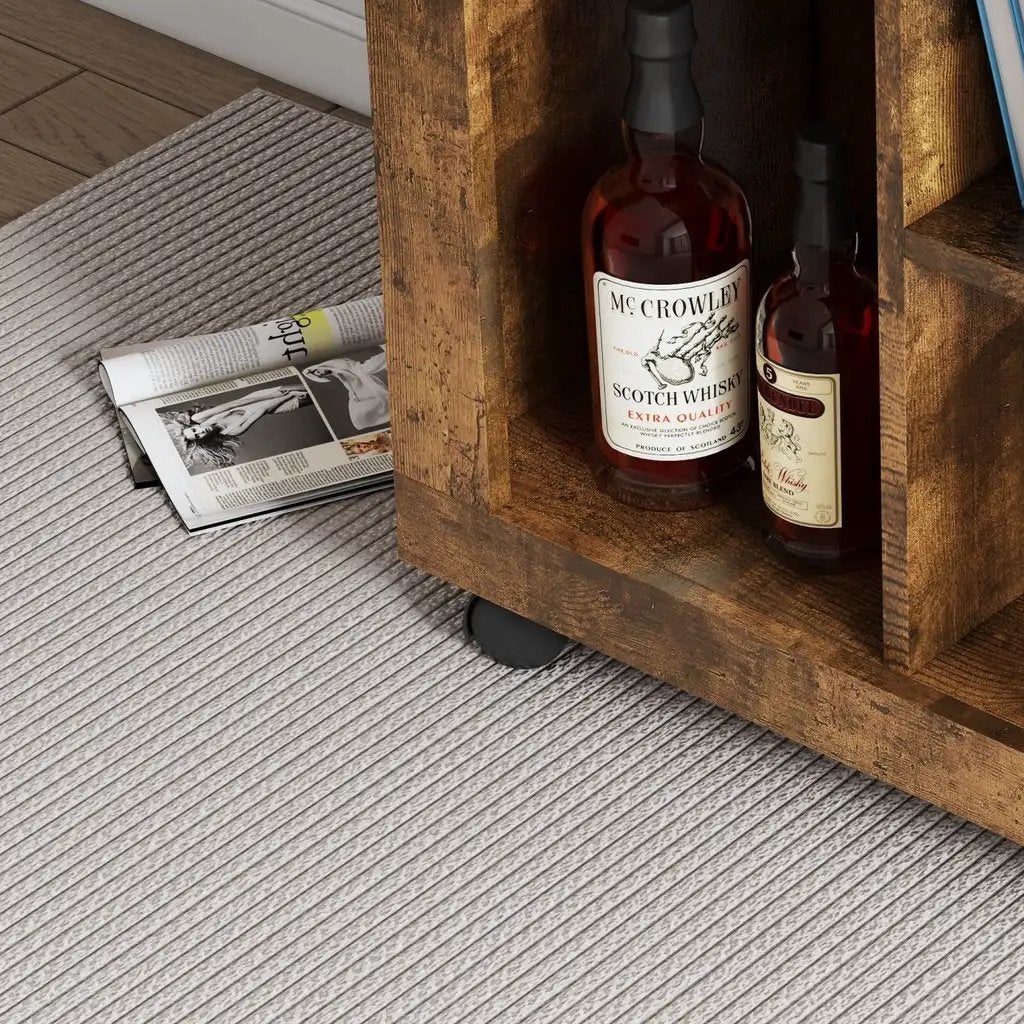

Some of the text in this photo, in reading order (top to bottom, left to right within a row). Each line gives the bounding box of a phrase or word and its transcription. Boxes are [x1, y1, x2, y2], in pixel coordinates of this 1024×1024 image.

[640, 276, 743, 319] CROWLEY
[612, 382, 678, 406] SCOTCH
[683, 367, 744, 405] WHISKY
[627, 399, 733, 423] EXTRA QUALITY
[629, 424, 657, 433] EXCLUSIVE
[659, 426, 689, 434] SELECTION
[698, 419, 718, 430] CHOICE
[719, 411, 737, 423] SCOTCH
[695, 424, 721, 436] BLENDED
[635, 443, 671, 453] PRODUCE
[690, 434, 728, 451] SCOTLAND
[773, 481, 795, 496] BLEND
[777, 466, 808, 493] Whisky
